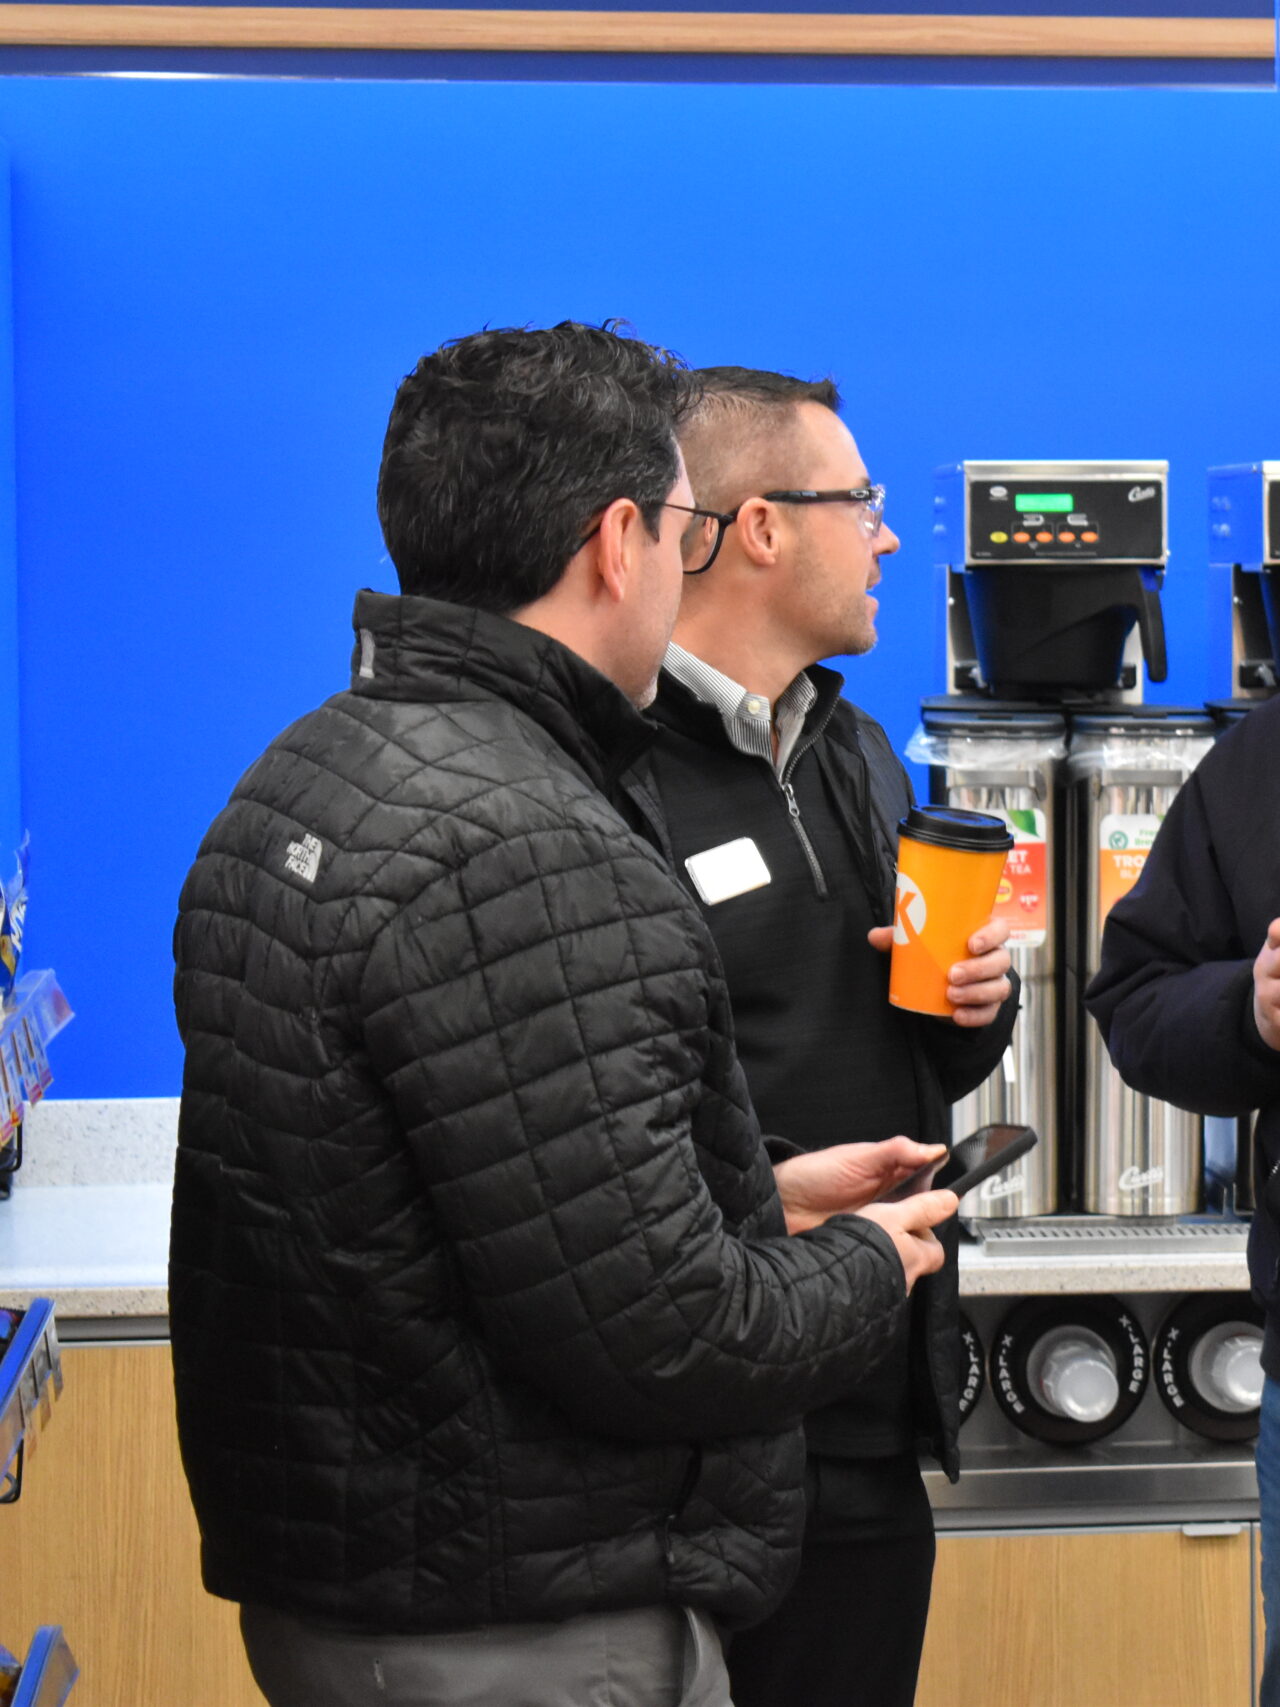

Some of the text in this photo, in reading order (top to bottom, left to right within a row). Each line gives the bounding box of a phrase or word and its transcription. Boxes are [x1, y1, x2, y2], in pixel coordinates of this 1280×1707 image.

[959, 1331, 980, 1411] X-LARGE
[999, 1333, 1025, 1413] X-LARGE
[1118, 1314, 1144, 1393] X-LARGE
[1162, 1327, 1185, 1408] X-LARGE
